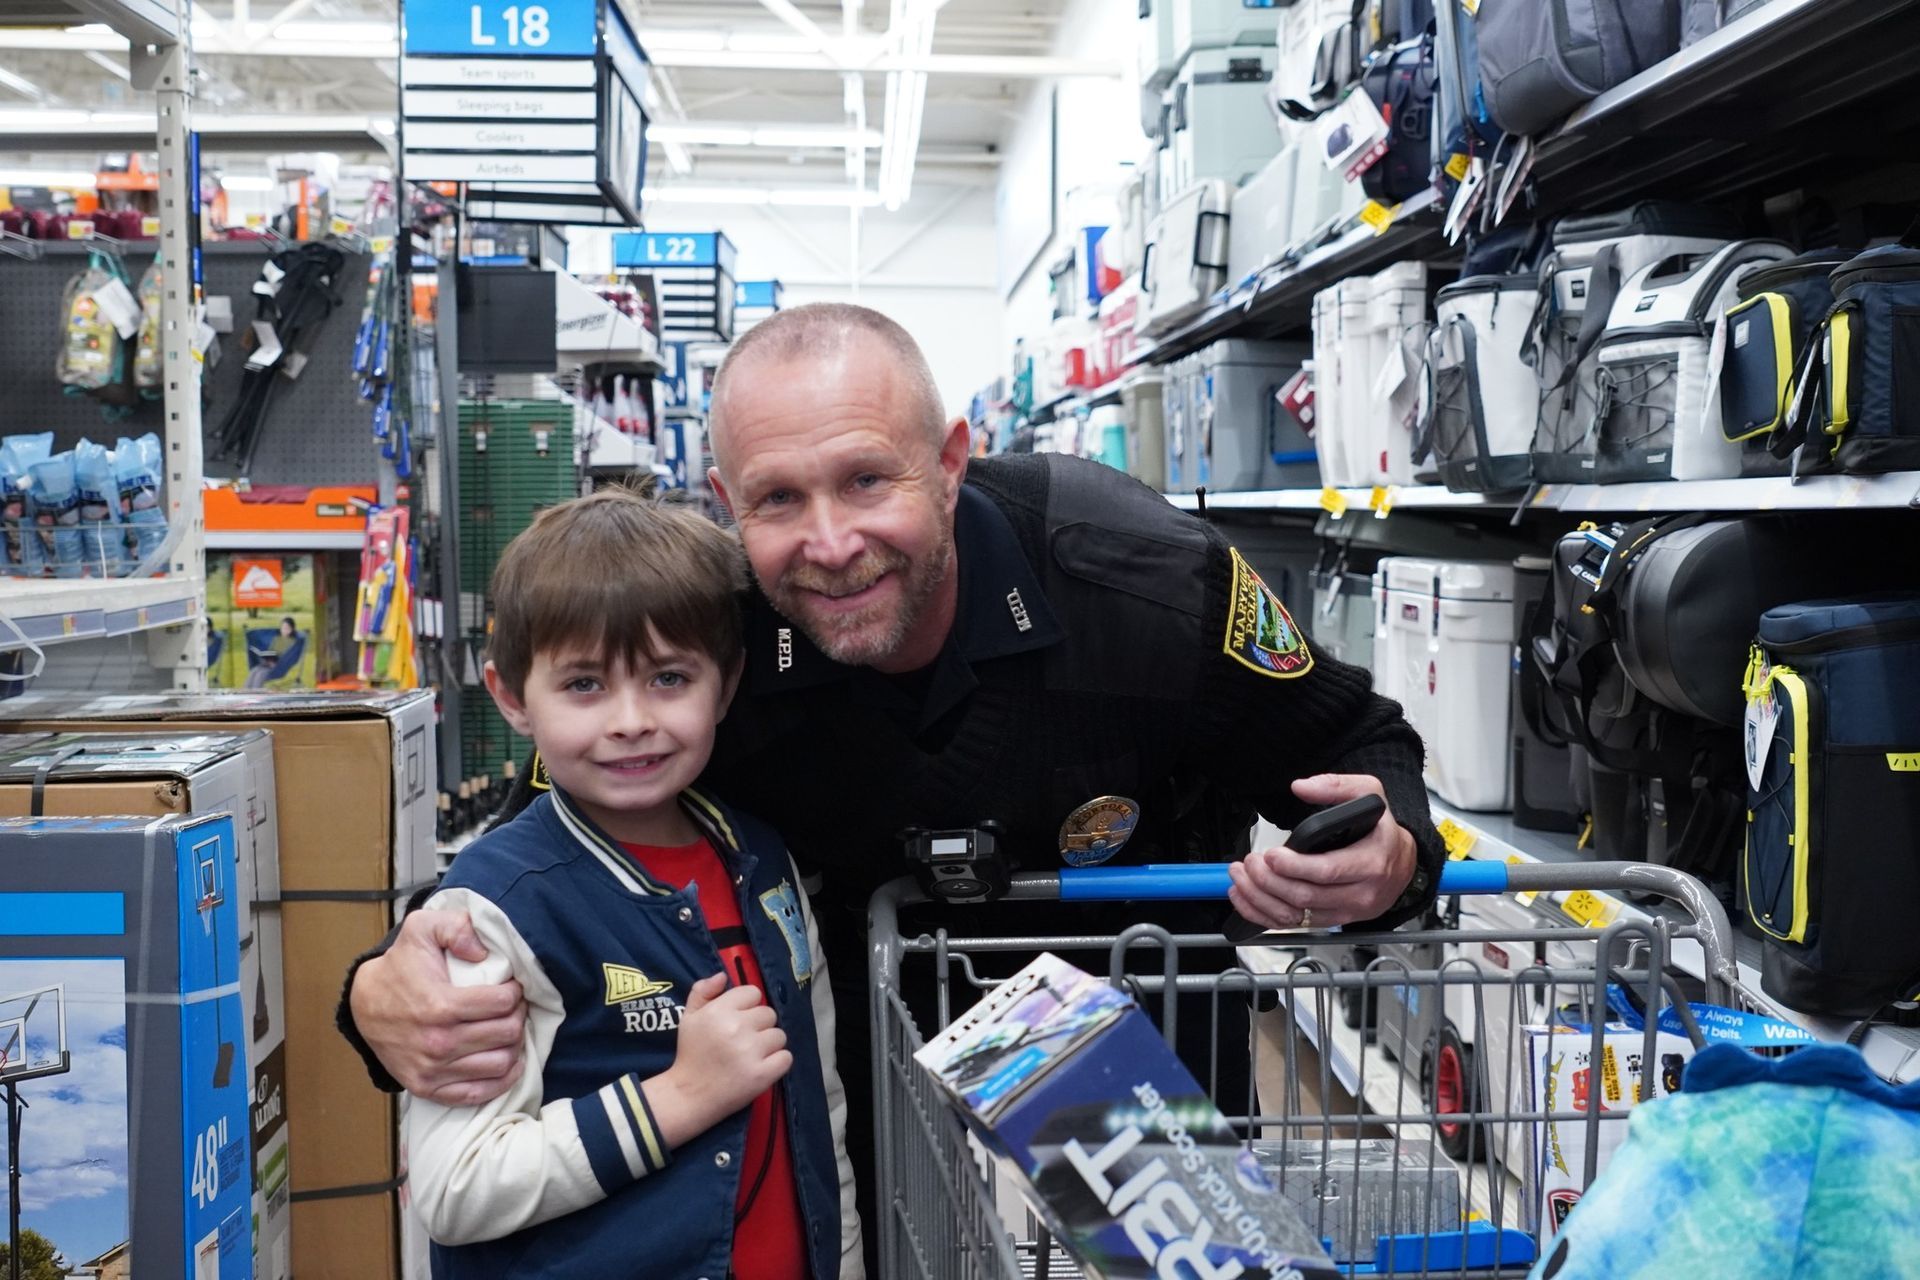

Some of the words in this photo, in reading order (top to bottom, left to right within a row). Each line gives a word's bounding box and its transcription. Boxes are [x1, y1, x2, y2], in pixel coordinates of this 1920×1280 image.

[471, 5, 496, 46] L
[502, 6, 550, 47] 18
[460, 66, 493, 79] Team
[496, 67, 536, 82] sports
[457, 98, 511, 114] Sleeping
[514, 99, 544, 114] bags
[475, 129, 525, 143] Coolers
[475, 162, 525, 175] Airbeds
[647, 237, 662, 261] L
[665, 237, 697, 261] 22
[778, 628, 793, 673] M.P.D.
[614, 972, 637, 994] LET
[620, 998, 655, 1012] HEAR
[1662, 1018, 1683, 1030] use
[1705, 1009, 1744, 1027] Always
[1711, 1025, 1742, 1040] belts.
[1131, 1081, 1204, 1172] Scooter
[1197, 1165, 1244, 1222] Kick
